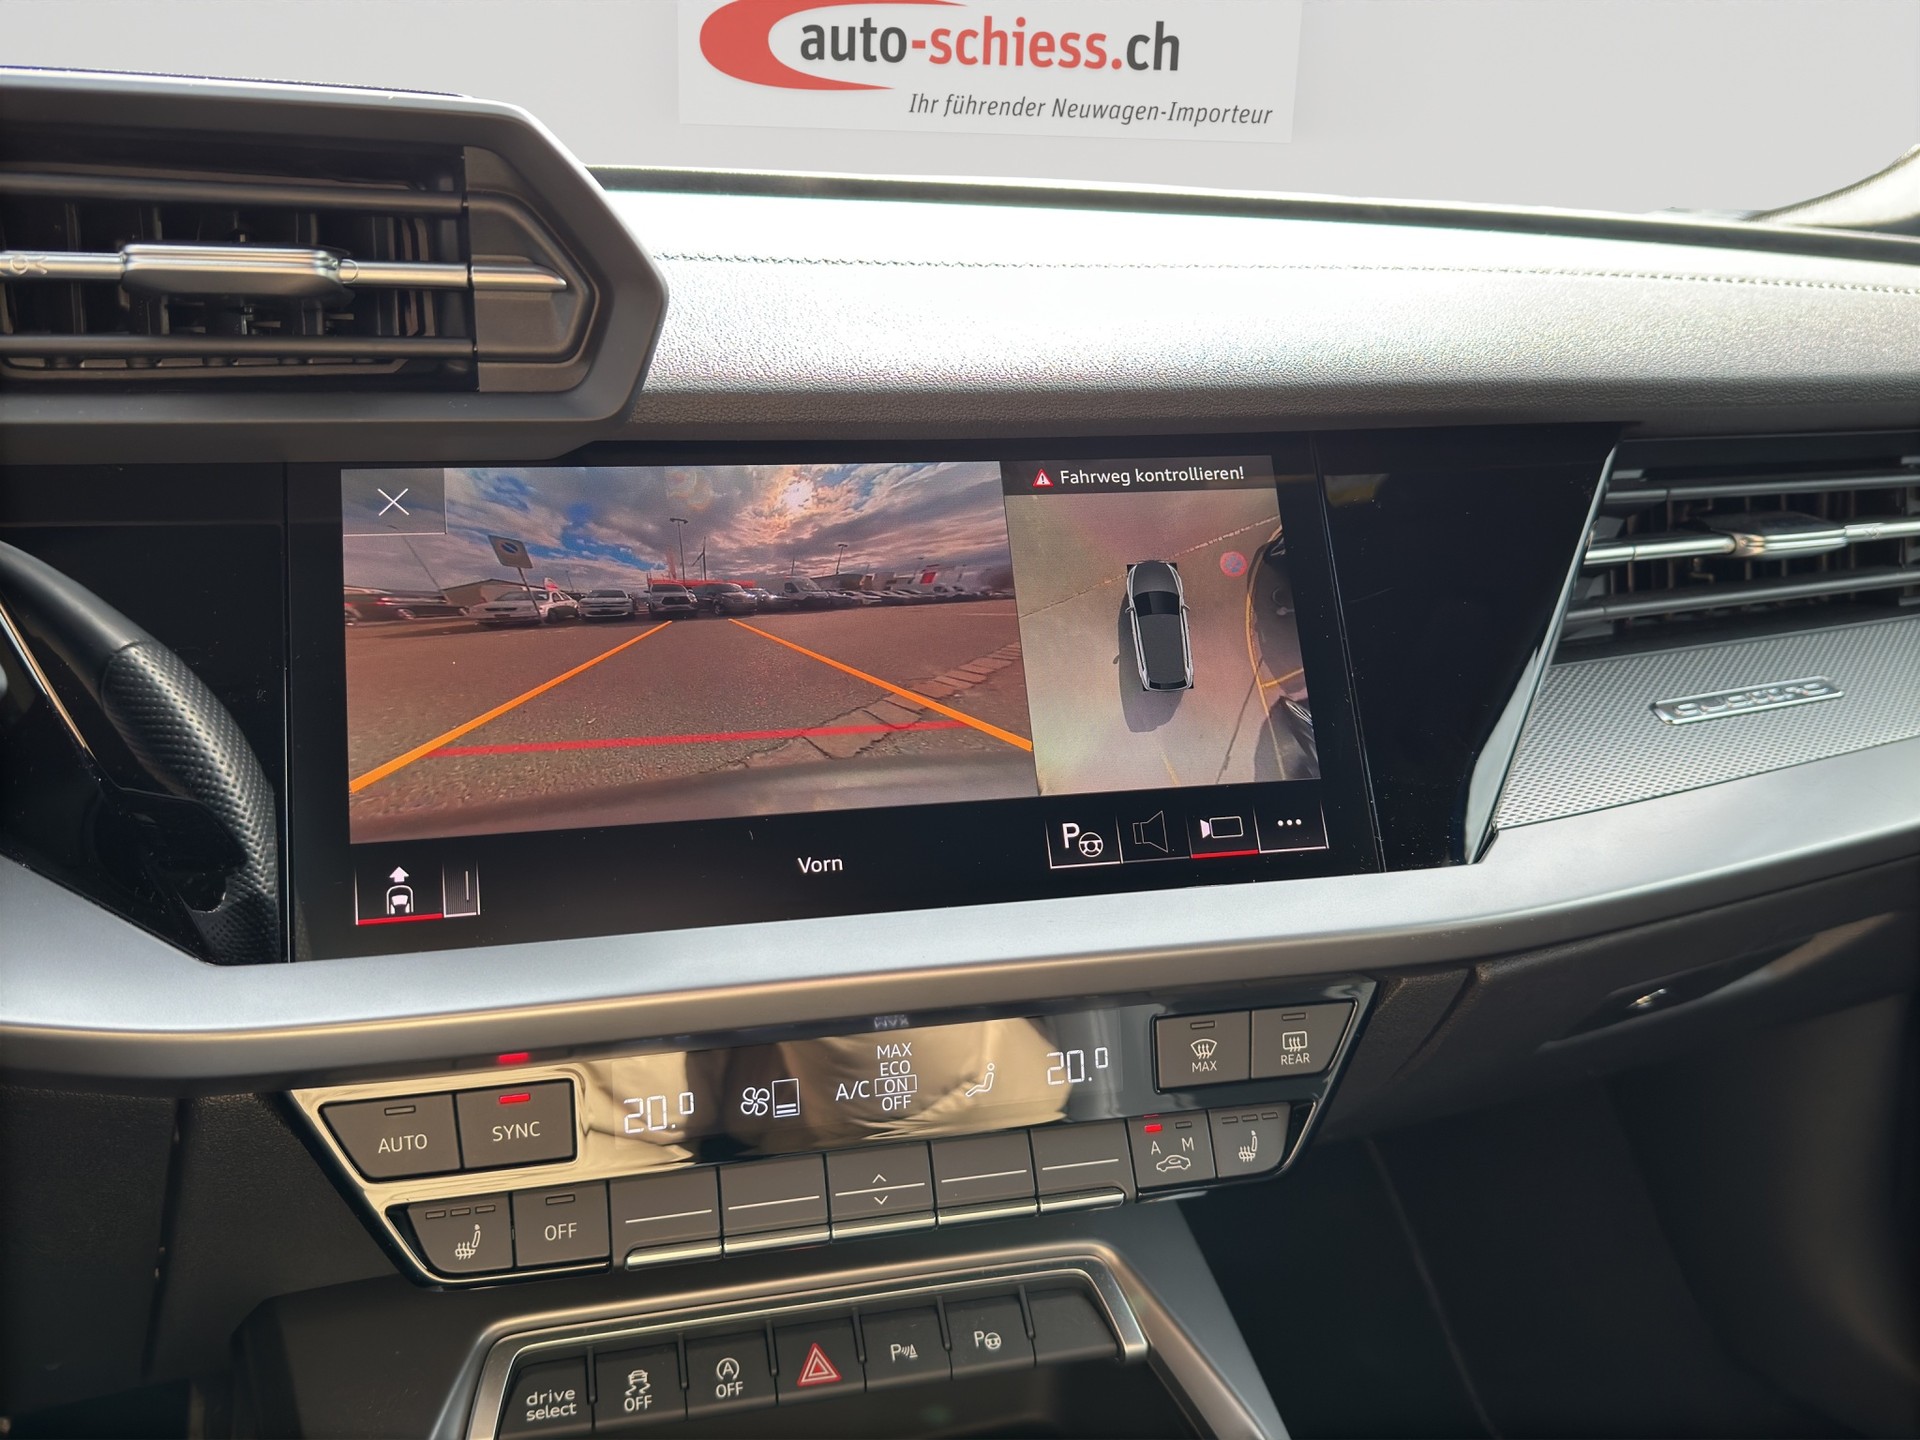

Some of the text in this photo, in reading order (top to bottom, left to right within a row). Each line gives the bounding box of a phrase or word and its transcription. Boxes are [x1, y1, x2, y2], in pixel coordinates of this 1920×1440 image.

[800, 15, 1180, 71] auto-schiess.ch
[909, 93, 1273, 127] Ihr führender Neuwagen-Importeur
[1060, 466, 1245, 487] Fahrweg kontrollieren!
[797, 856, 844, 874] Vorn
[876, 1042, 912, 1059] MAX
[1280, 1052, 1311, 1066] REAR
[880, 1060, 911, 1077] ECO
[1191, 1060, 1218, 1073] MAX
[835, 1080, 871, 1101] A/C
[884, 1078, 908, 1094] ON
[881, 1094, 912, 1111] OFF
[492, 1121, 541, 1142] SYNC
[378, 1133, 428, 1154] AUTO
[1150, 1136, 1195, 1155] A M
[544, 1222, 578, 1241] OFF
[526, 1388, 576, 1407] drive
[715, 1381, 744, 1399] OFF
[526, 1402, 577, 1422] select
[623, 1394, 653, 1413] OFF
